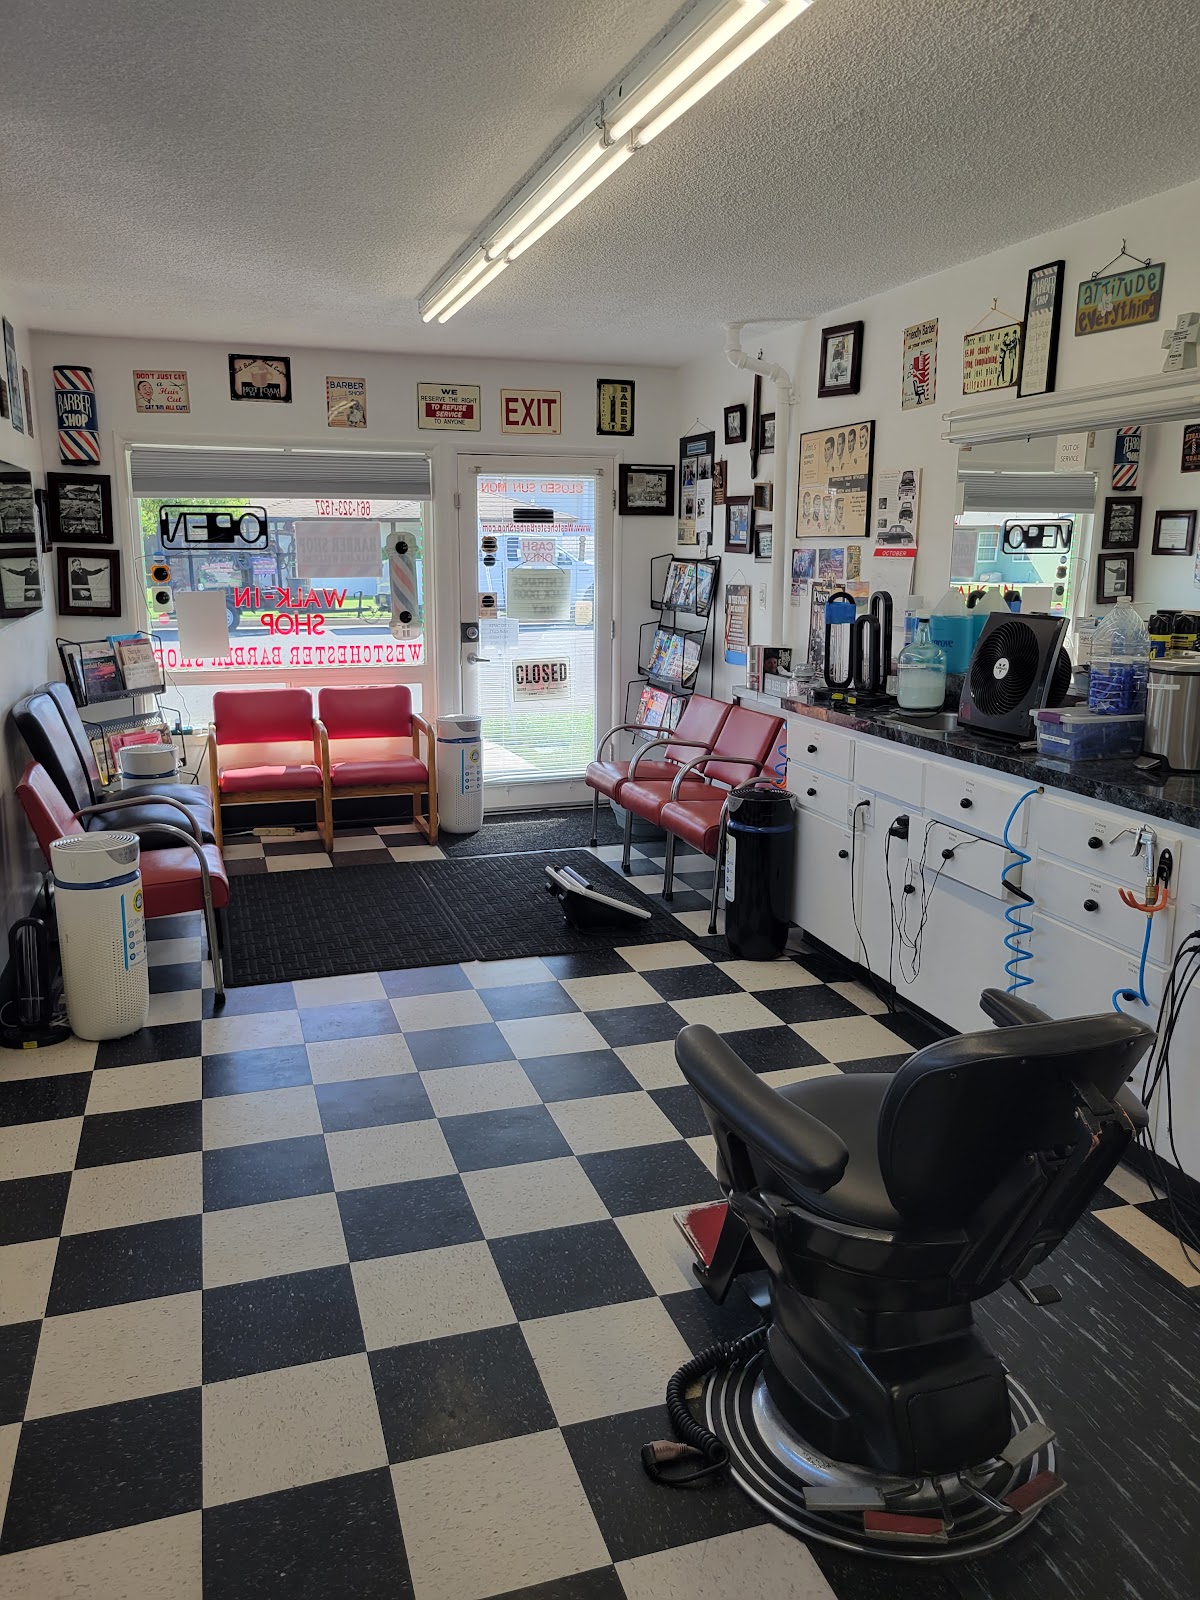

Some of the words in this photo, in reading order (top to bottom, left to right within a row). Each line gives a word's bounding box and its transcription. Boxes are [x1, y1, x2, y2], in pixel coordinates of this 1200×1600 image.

[1031, 275, 1057, 298] BARBER
[922, 324, 936, 336] Barber
[158, 387, 180, 395] Hair
[330, 381, 364, 390] BARBER
[441, 388, 458, 396] WE
[166, 395, 182, 403] Cut
[420, 395, 446, 403] RESERVE
[57, 393, 93, 419] BARBER
[505, 397, 557, 427] EXIT
[620, 386, 629, 431] BARBER
[62, 413, 89, 427] SHOP
[443, 418, 466, 426] ANYONE
[1061, 444, 1072, 452] OUT
[1072, 443, 1080, 451] OF
[1007, 524, 1070, 549] OPEN
[515, 662, 568, 685] CLOSED
